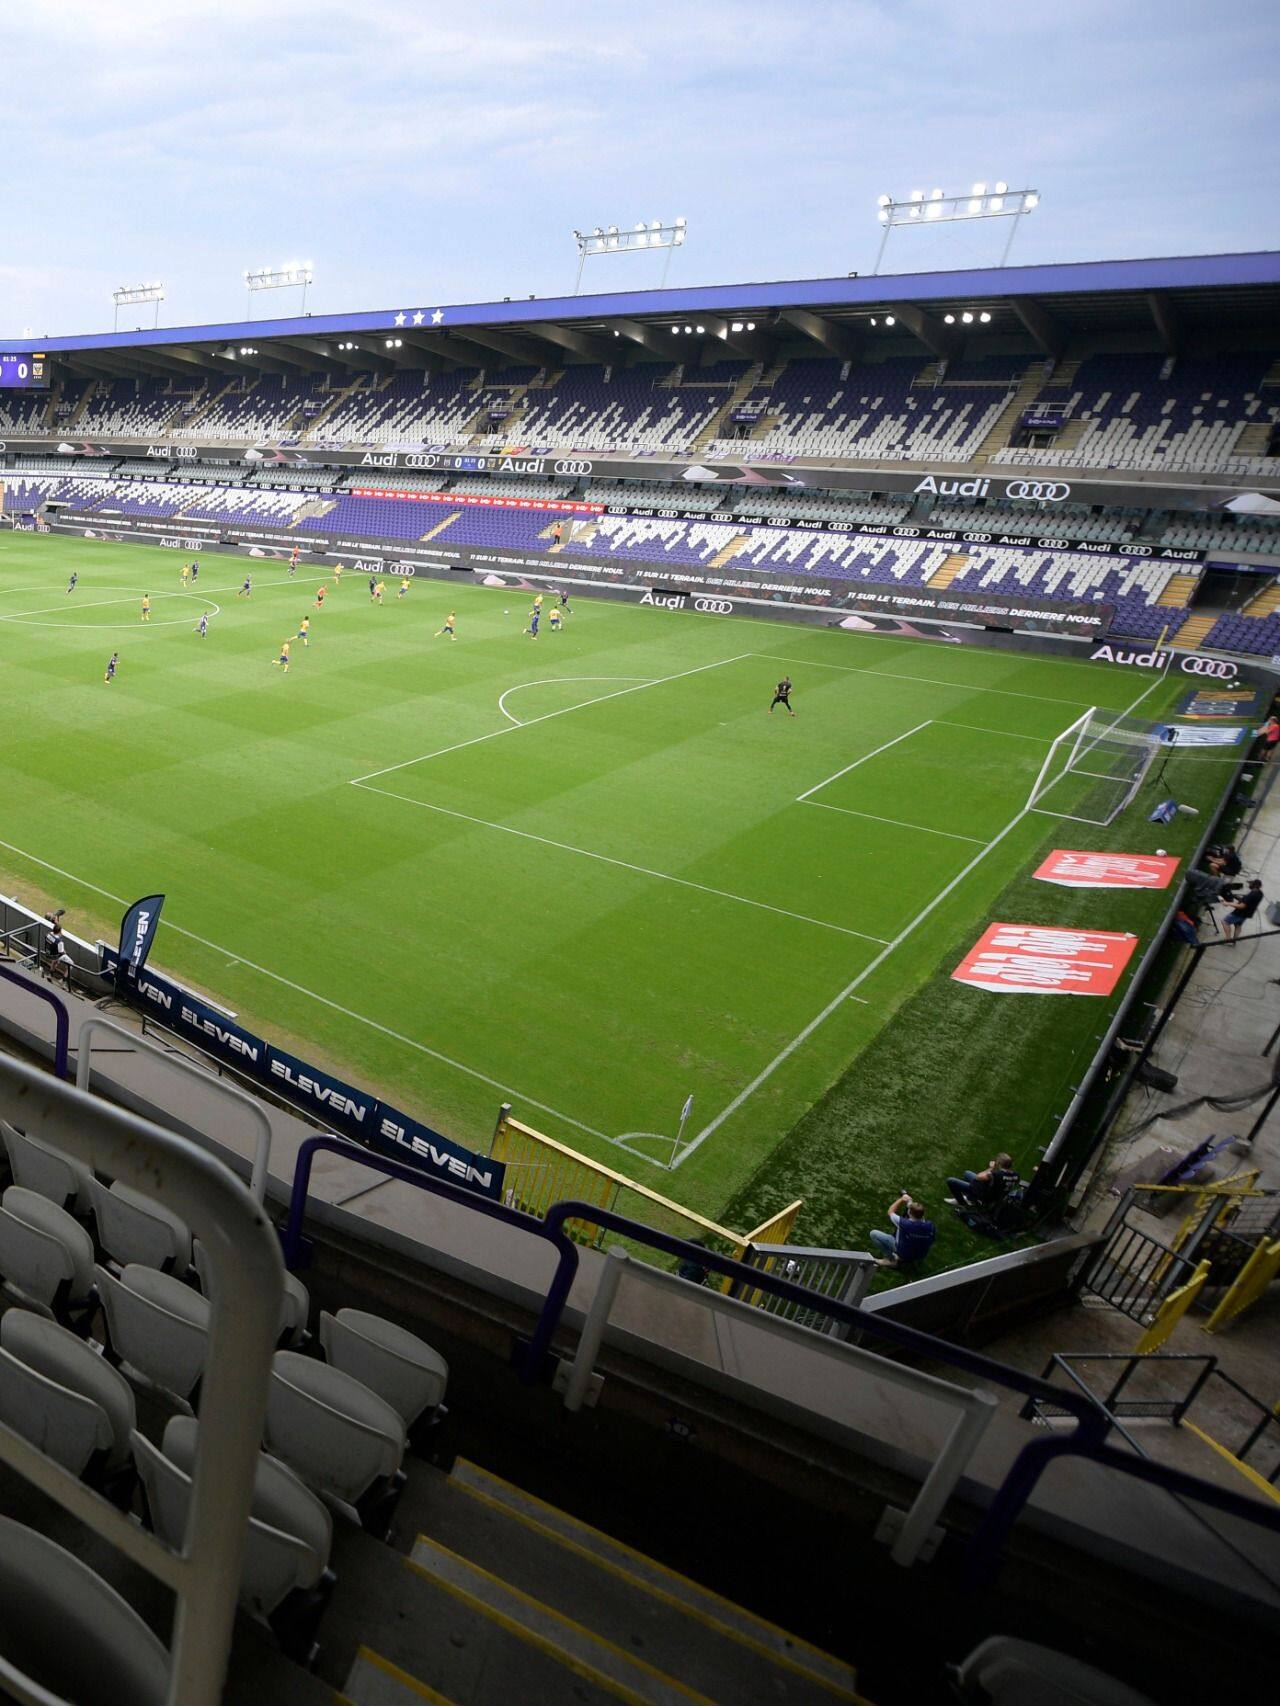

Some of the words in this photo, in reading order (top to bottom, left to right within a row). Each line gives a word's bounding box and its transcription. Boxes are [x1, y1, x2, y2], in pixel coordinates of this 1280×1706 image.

[18, 363, 28, 379] 0
[146, 446, 170, 457] Audi
[361, 453, 398, 467] Audi
[455, 457, 462, 468] 0
[478, 459, 485, 469] 0
[500, 458, 545, 474] Audi
[914, 475, 990, 497] Audi
[632, 508, 653, 516] Audi
[684, 512, 706, 520] Audi
[738, 516, 762, 524] Audi
[796, 520, 822, 529] Audi
[15, 523, 35, 531] Audi
[860, 525, 886, 535] Audi
[926, 529, 956, 540] Audi
[160, 538, 180, 548] Audi
[999, 535, 1030, 547] Audi
[1077, 542, 1112, 553] Audi
[1161, 548, 1199, 560] Audi
[354, 559, 383, 572] Audi
[670, 574, 704, 584] TERRAIN.
[761, 583, 802, 594] DERRIERE
[803, 587, 832, 596] NOUS.
[640, 592, 684, 610] Audi
[848, 592, 856, 600] 11
[856, 592, 876, 602] SUR
[892, 596, 936, 608] TERRAIN.
[938, 601, 957, 610] DES
[960, 602, 1008, 615] MILLIERS
[1009, 609, 1065, 621] DERRIERE
[1066, 614, 1102, 626] NOUS.
[1090, 645, 1166, 668] Audi
[128, 910, 150, 978] ELEVEN
[181, 1006, 258, 1062] ELEVEN
[271, 1060, 366, 1122] ELEVEN
[380, 1118, 492, 1188] ELEVEN
